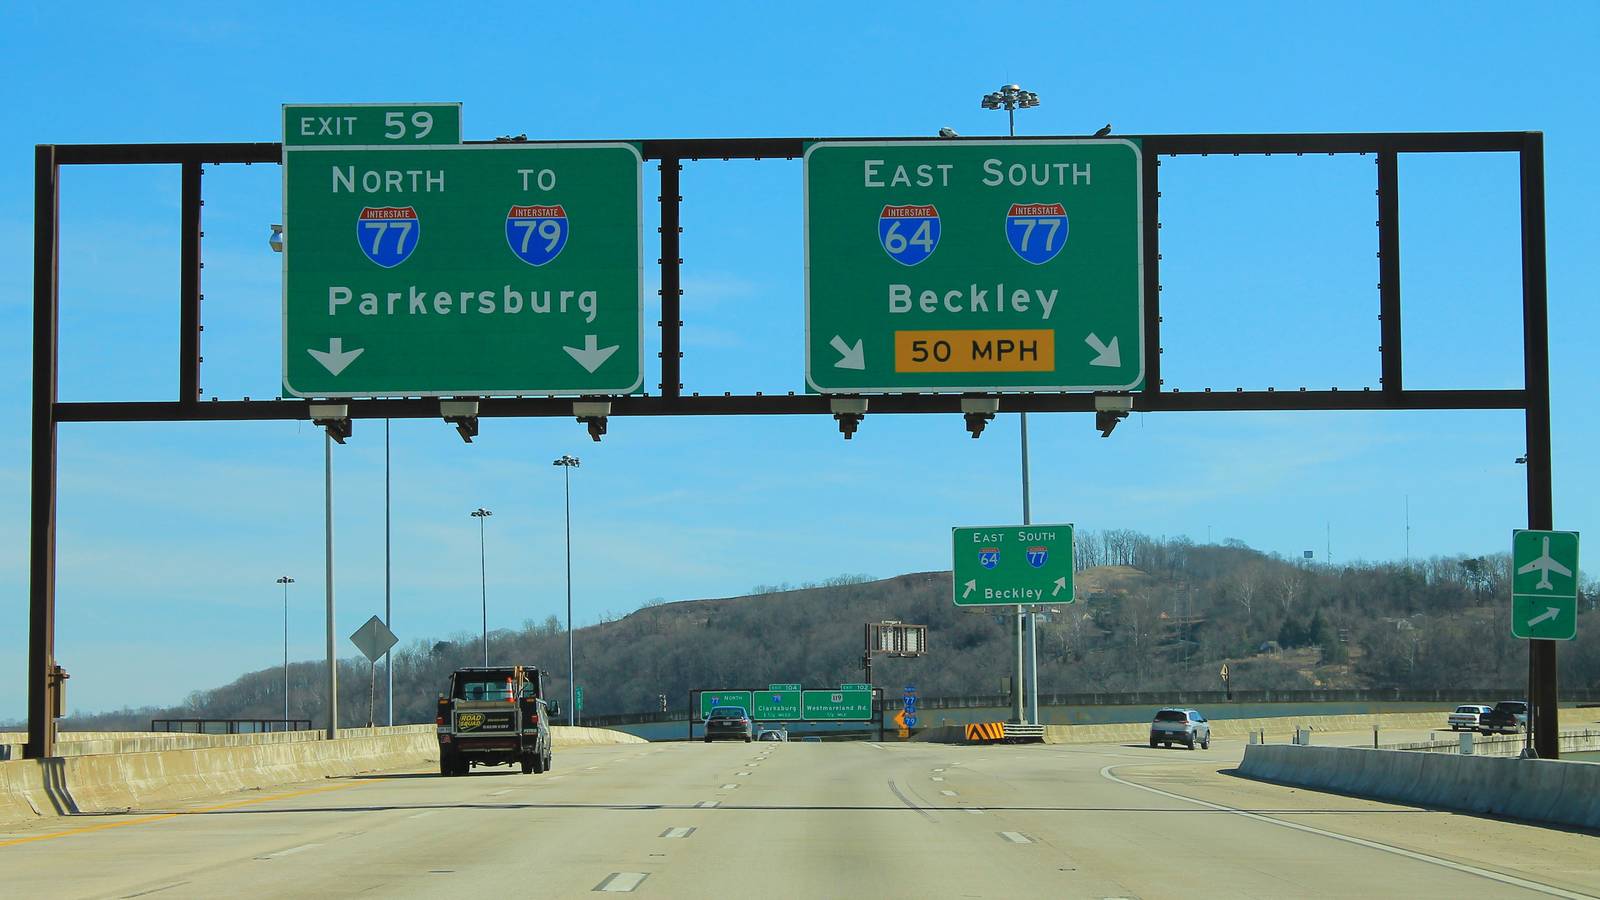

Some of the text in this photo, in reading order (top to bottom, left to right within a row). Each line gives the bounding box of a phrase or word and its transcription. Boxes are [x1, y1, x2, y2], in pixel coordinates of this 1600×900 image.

[301, 111, 433, 139] EXIT 59
[864, 158, 1092, 187] EAST SOUTH
[332, 166, 556, 192] NORTH TO
[366, 210, 410, 219] INTERSTATE
[515, 208, 559, 217] INTERSTATE
[888, 208, 931, 217] INTERSTATE
[1015, 207, 1059, 215] INTERSTATE
[364, 222, 412, 254] 77
[513, 220, 561, 253] 79
[885, 220, 933, 254] 64
[1013, 219, 1061, 252] 77
[328, 285, 598, 323] Parkersburg
[888, 284, 1059, 320] Beckley
[911, 340, 1038, 363] 50 MPH
[973, 531, 1056, 543] EAST SOUTH
[980, 553, 998, 565] 64
[1029, 551, 1045, 563] 77
[984, 588, 1043, 600] Beckley
[711, 696, 720, 704] 77
[904, 696, 915, 704] 77
[461, 713, 482, 721] ROAD
[905, 717, 914, 725] 79
[459, 720, 480, 728] SQUAD
